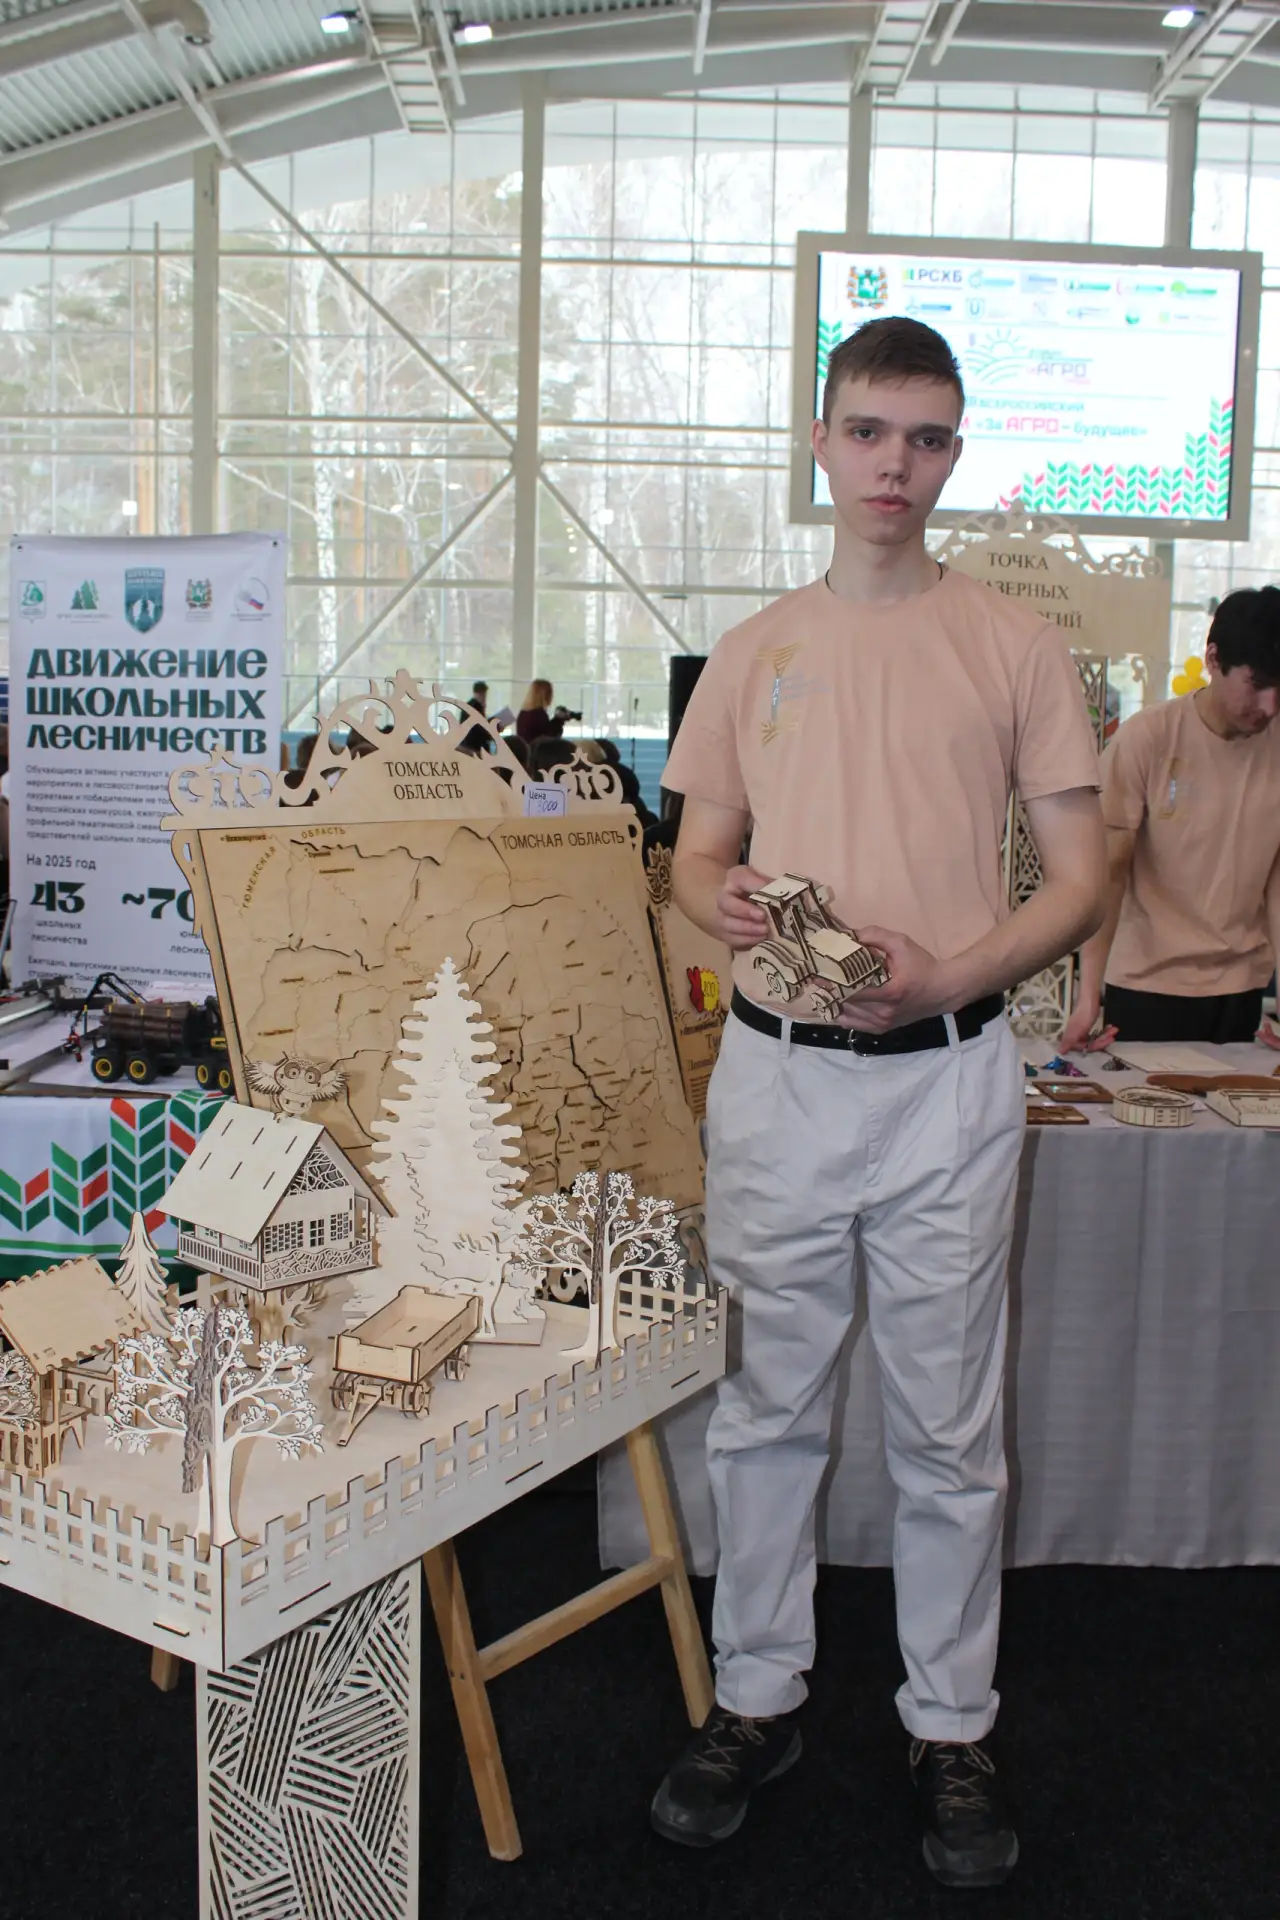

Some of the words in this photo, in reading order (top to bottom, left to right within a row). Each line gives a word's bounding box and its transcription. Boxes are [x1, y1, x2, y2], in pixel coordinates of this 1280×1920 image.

[917, 269, 963, 285] РСХБ
[1006, 416, 1060, 434] АГРО
[987, 551, 1049, 571] ТОЧКА
[978, 579, 1069, 600] ЗЕРНЫХ
[26, 686, 267, 720] ШКОЛЬНЫХ
[384, 761, 462, 778] ТОМСКАЯ
[393, 784, 464, 800] ОБЛАСТЬ
[528, 790, 547, 801] Цена
[500, 833, 564, 850] ТОМСКАЯ
[567, 830, 625, 847] ОБЛАСТЬ
[26, 854, 42, 867] На
[45, 855, 72, 868] 2025
[75, 858, 97, 871] год
[29, 880, 86, 914] 43
